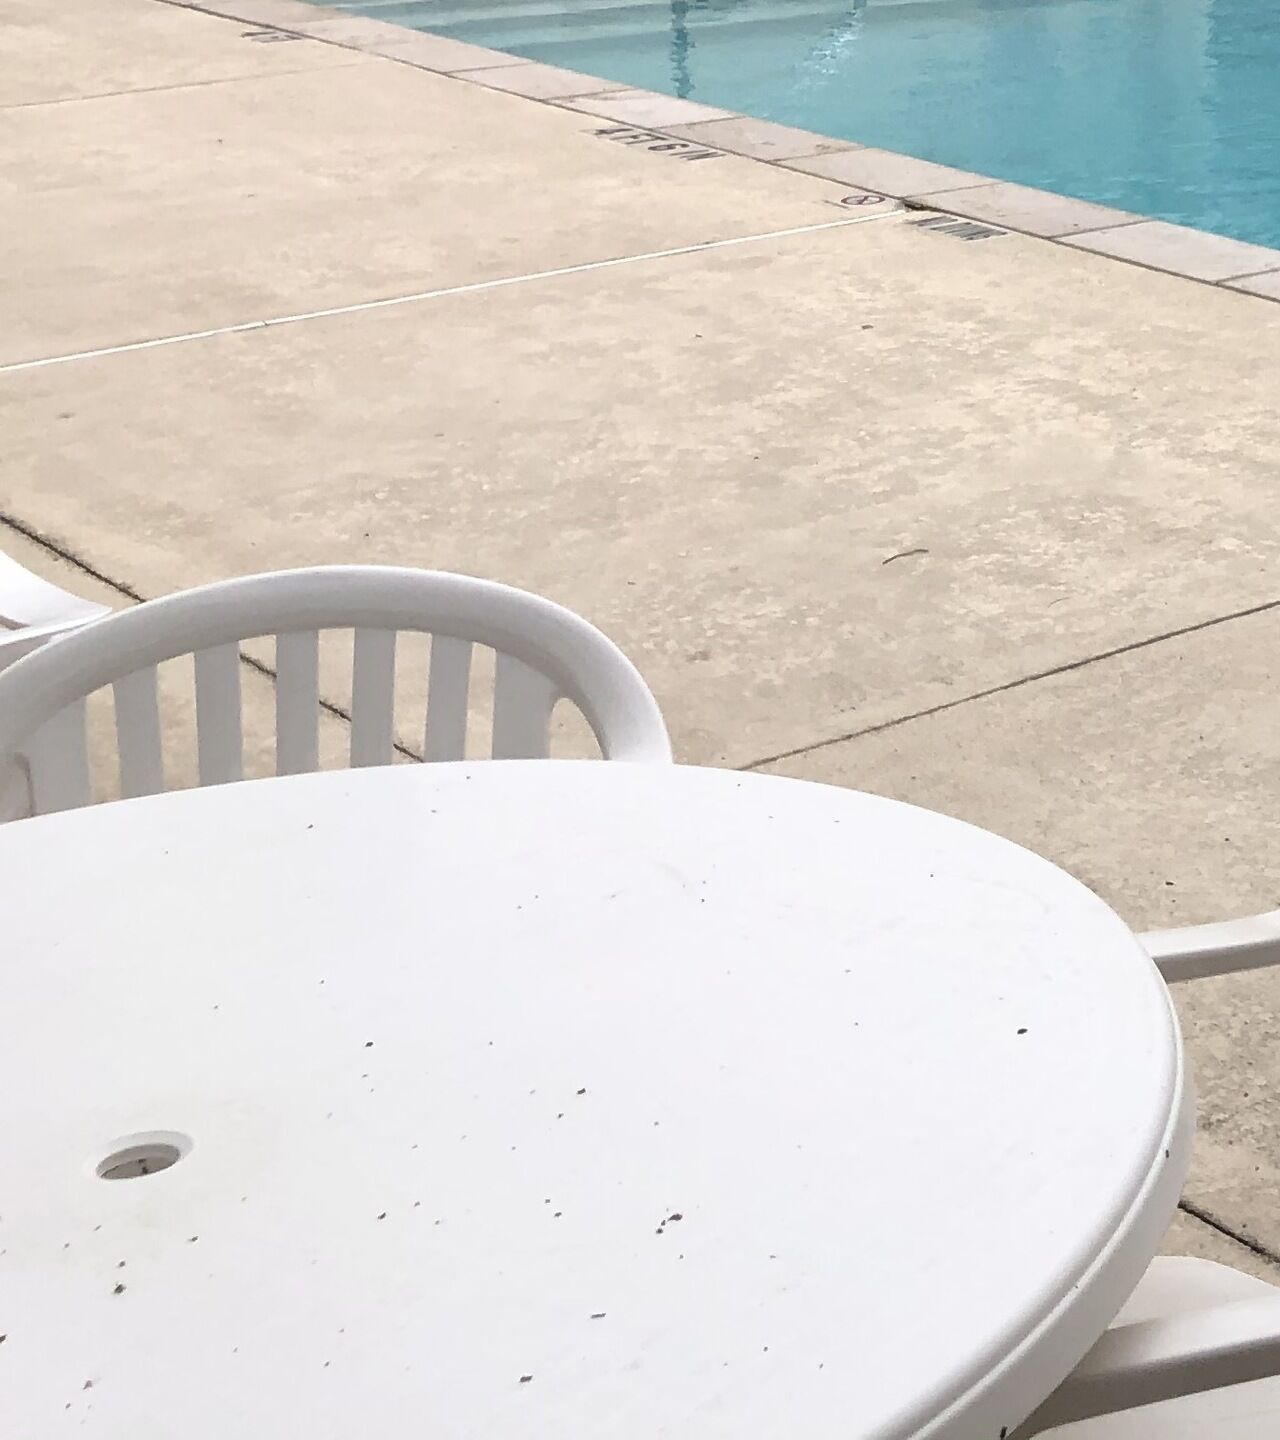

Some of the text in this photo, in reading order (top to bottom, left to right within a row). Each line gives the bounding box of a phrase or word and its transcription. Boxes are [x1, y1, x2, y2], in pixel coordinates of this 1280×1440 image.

[609, 132, 670, 145] FT
[647, 143, 690, 152] 6
[669, 150, 728, 161] IN
